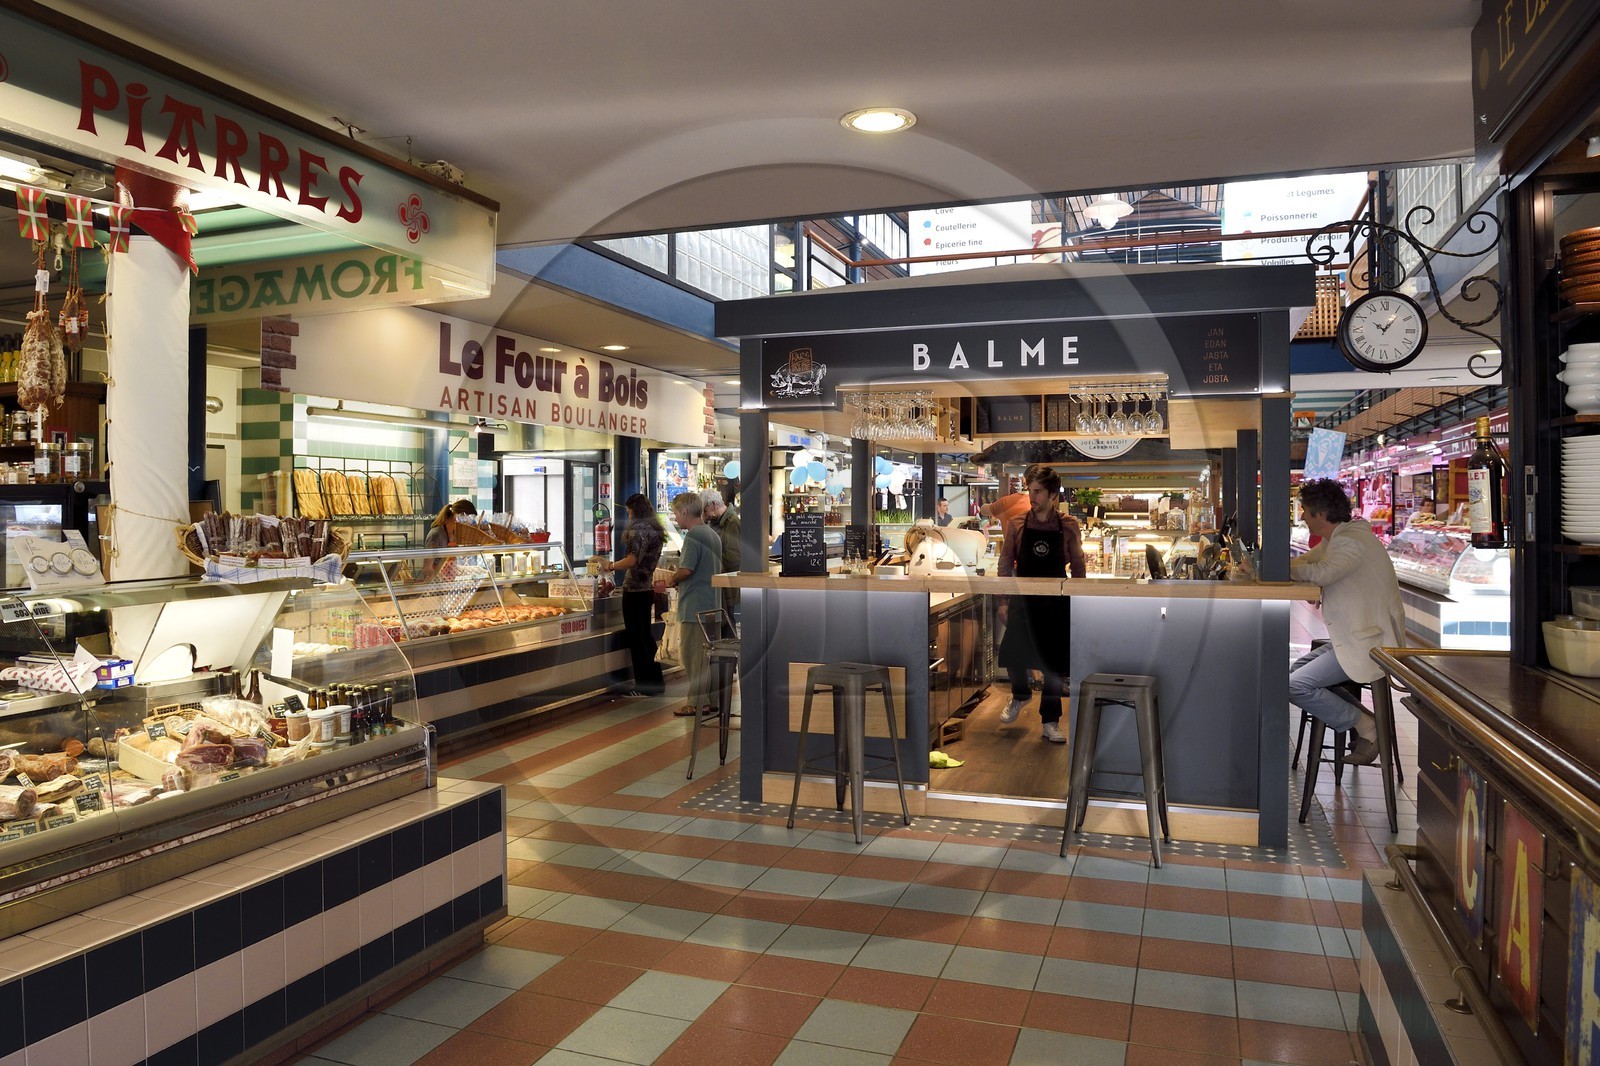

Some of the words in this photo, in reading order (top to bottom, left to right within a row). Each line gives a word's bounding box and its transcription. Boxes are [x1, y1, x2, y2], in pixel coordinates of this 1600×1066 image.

[1260, 212, 1318, 222] Poissonnerie
[935, 222, 977, 232] Coutellerie
[1260, 236, 1298, 244] Produits
[935, 240, 967, 250] Epicerie
[1207, 328, 1224, 336] JAN
[1205, 340, 1227, 348] EDAN
[913, 336, 1079, 370] BALME
[1203, 351, 1229, 360] JASTA
[439, 321, 484, 380] Le
[495, 335, 568, 394] Four
[573, 357, 590, 399] à
[598, 360, 648, 410] Bois
[1208, 363, 1223, 371] ETA
[1203, 374, 1229, 383] JOSTA
[439, 385, 537, 419] ARTISAN
[551, 402, 647, 435] BOULANGER
